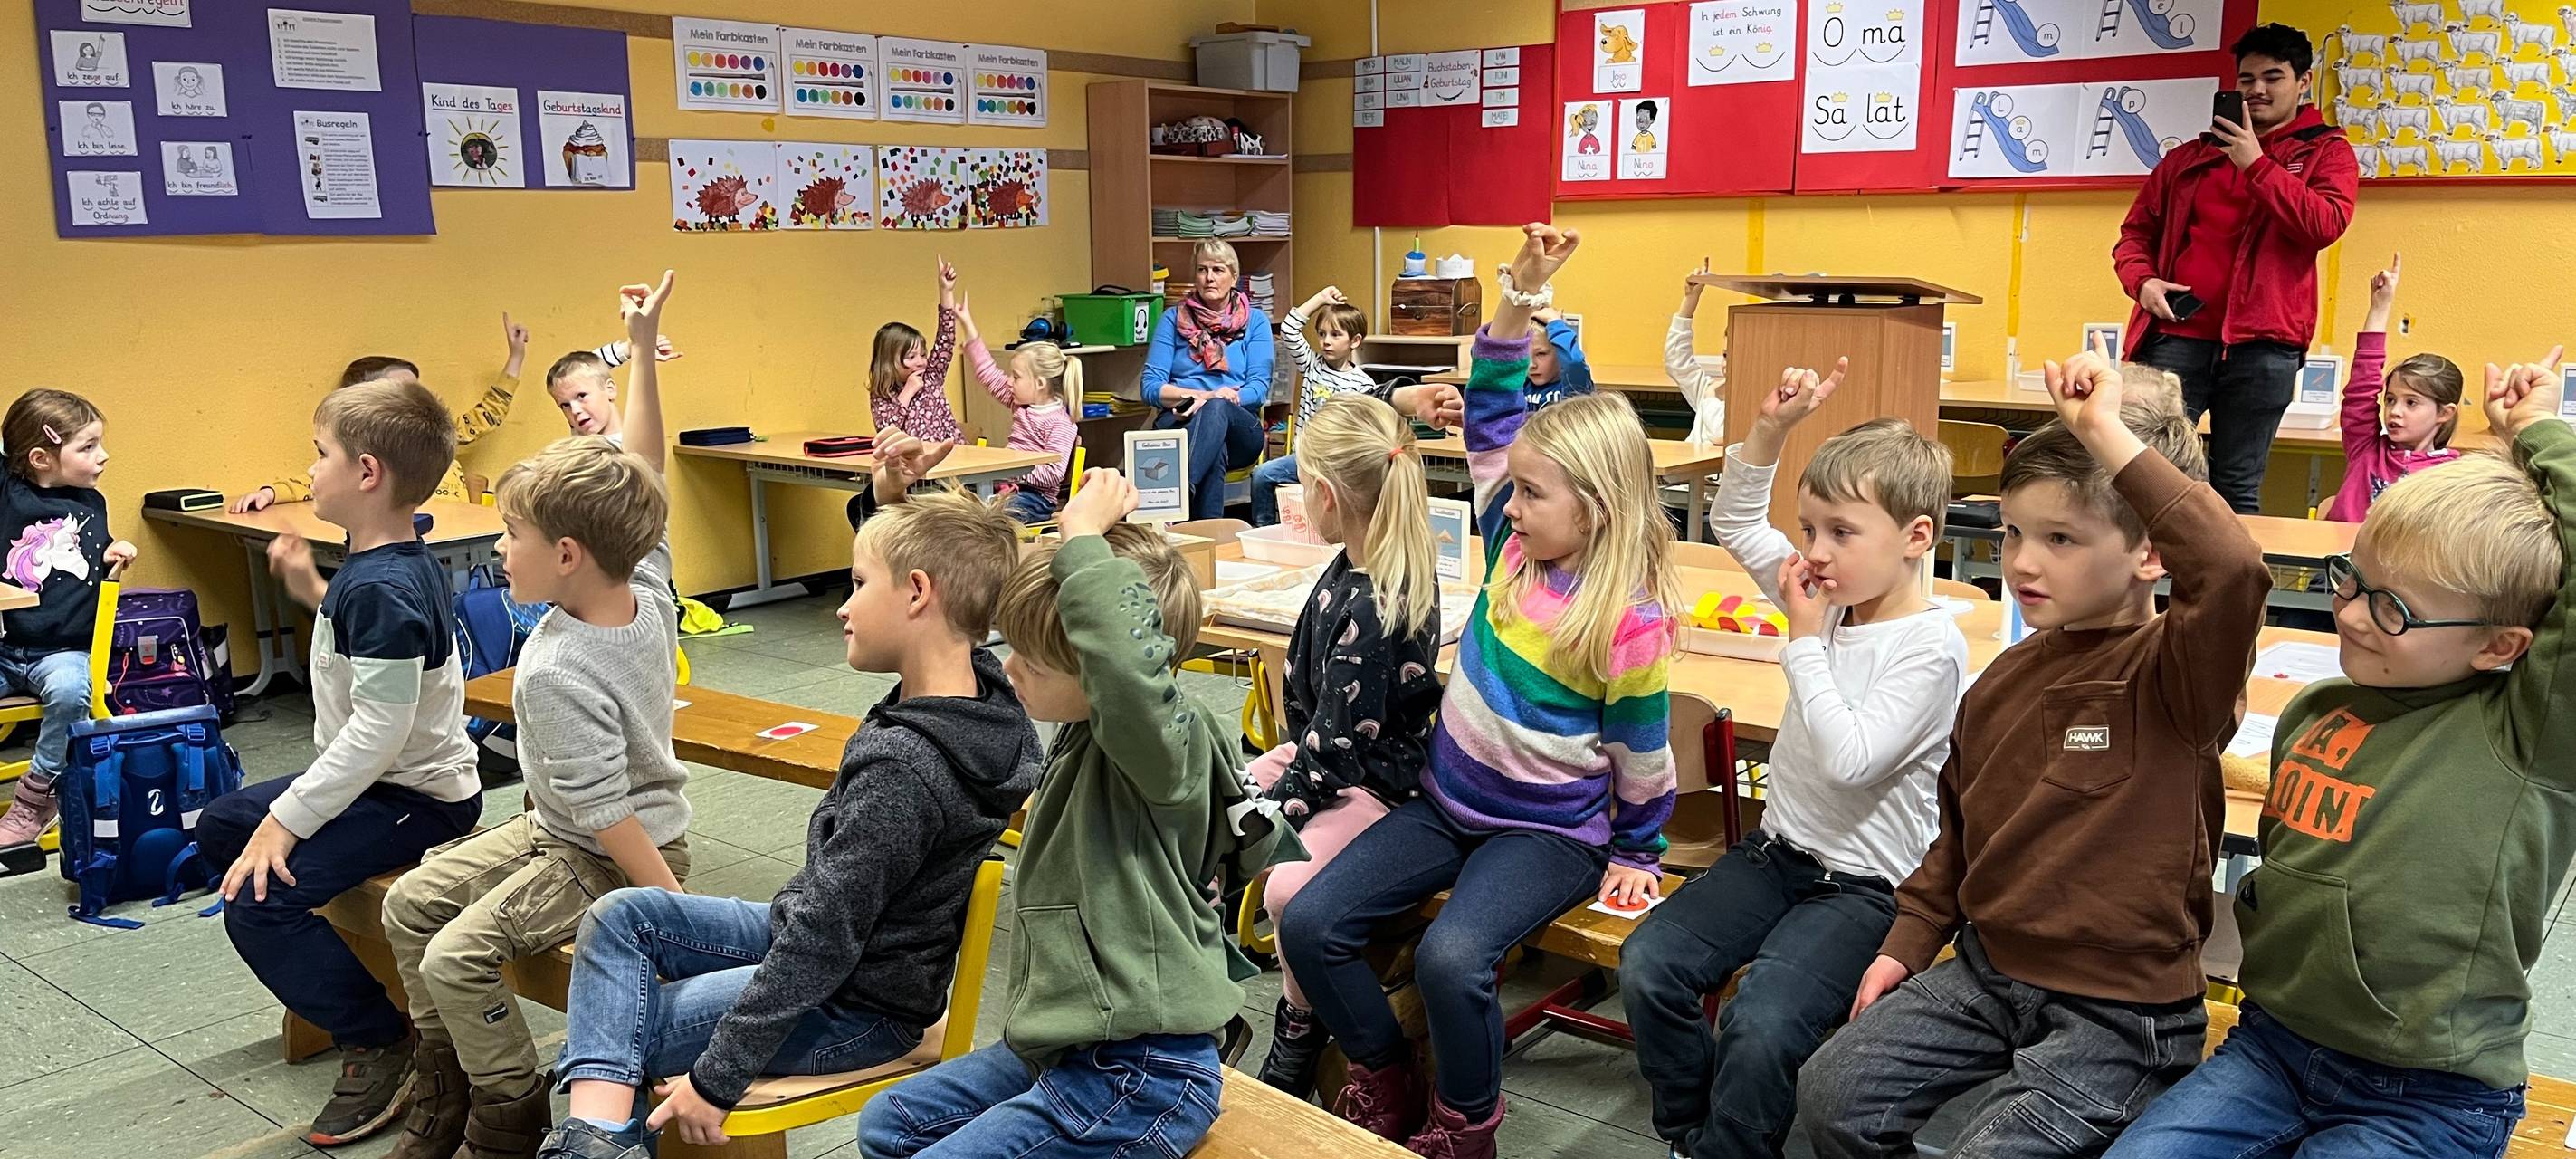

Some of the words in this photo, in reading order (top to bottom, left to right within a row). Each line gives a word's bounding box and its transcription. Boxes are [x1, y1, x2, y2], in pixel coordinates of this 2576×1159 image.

[1701, 11, 1708, 21] In
[1713, 9, 1737, 22] jedem
[1742, 6, 1782, 17] Schwung
[690, 29, 714, 41] Mein
[715, 31, 768, 44] Farbkasten
[1713, 27, 1724, 36] ist
[1729, 26, 1741, 35] ein
[1862, 25, 1906, 45] ma
[795, 39, 817, 50] Mein
[818, 41, 867, 54] Farbkasten
[892, 47, 911, 58] Mein
[912, 49, 956, 62] Farbkasten
[978, 53, 997, 64] Mein
[997, 55, 1038, 67] Farbkasten
[1427, 61, 1474, 72] Buchstaben-
[1430, 78, 1472, 88] Geburtstag
[1610, 70, 1627, 83] Jojo
[431, 93, 456, 108] Kind
[462, 96, 480, 110] des
[485, 97, 513, 113] Tages
[543, 100, 622, 116] Geburtstagskind
[1814, 95, 1847, 125] Sa
[1866, 93, 1906, 124] lat
[316, 119, 358, 130] Busregeln
[1578, 159, 1598, 170] Nina
[2068, 732, 2104, 743] HAWK
